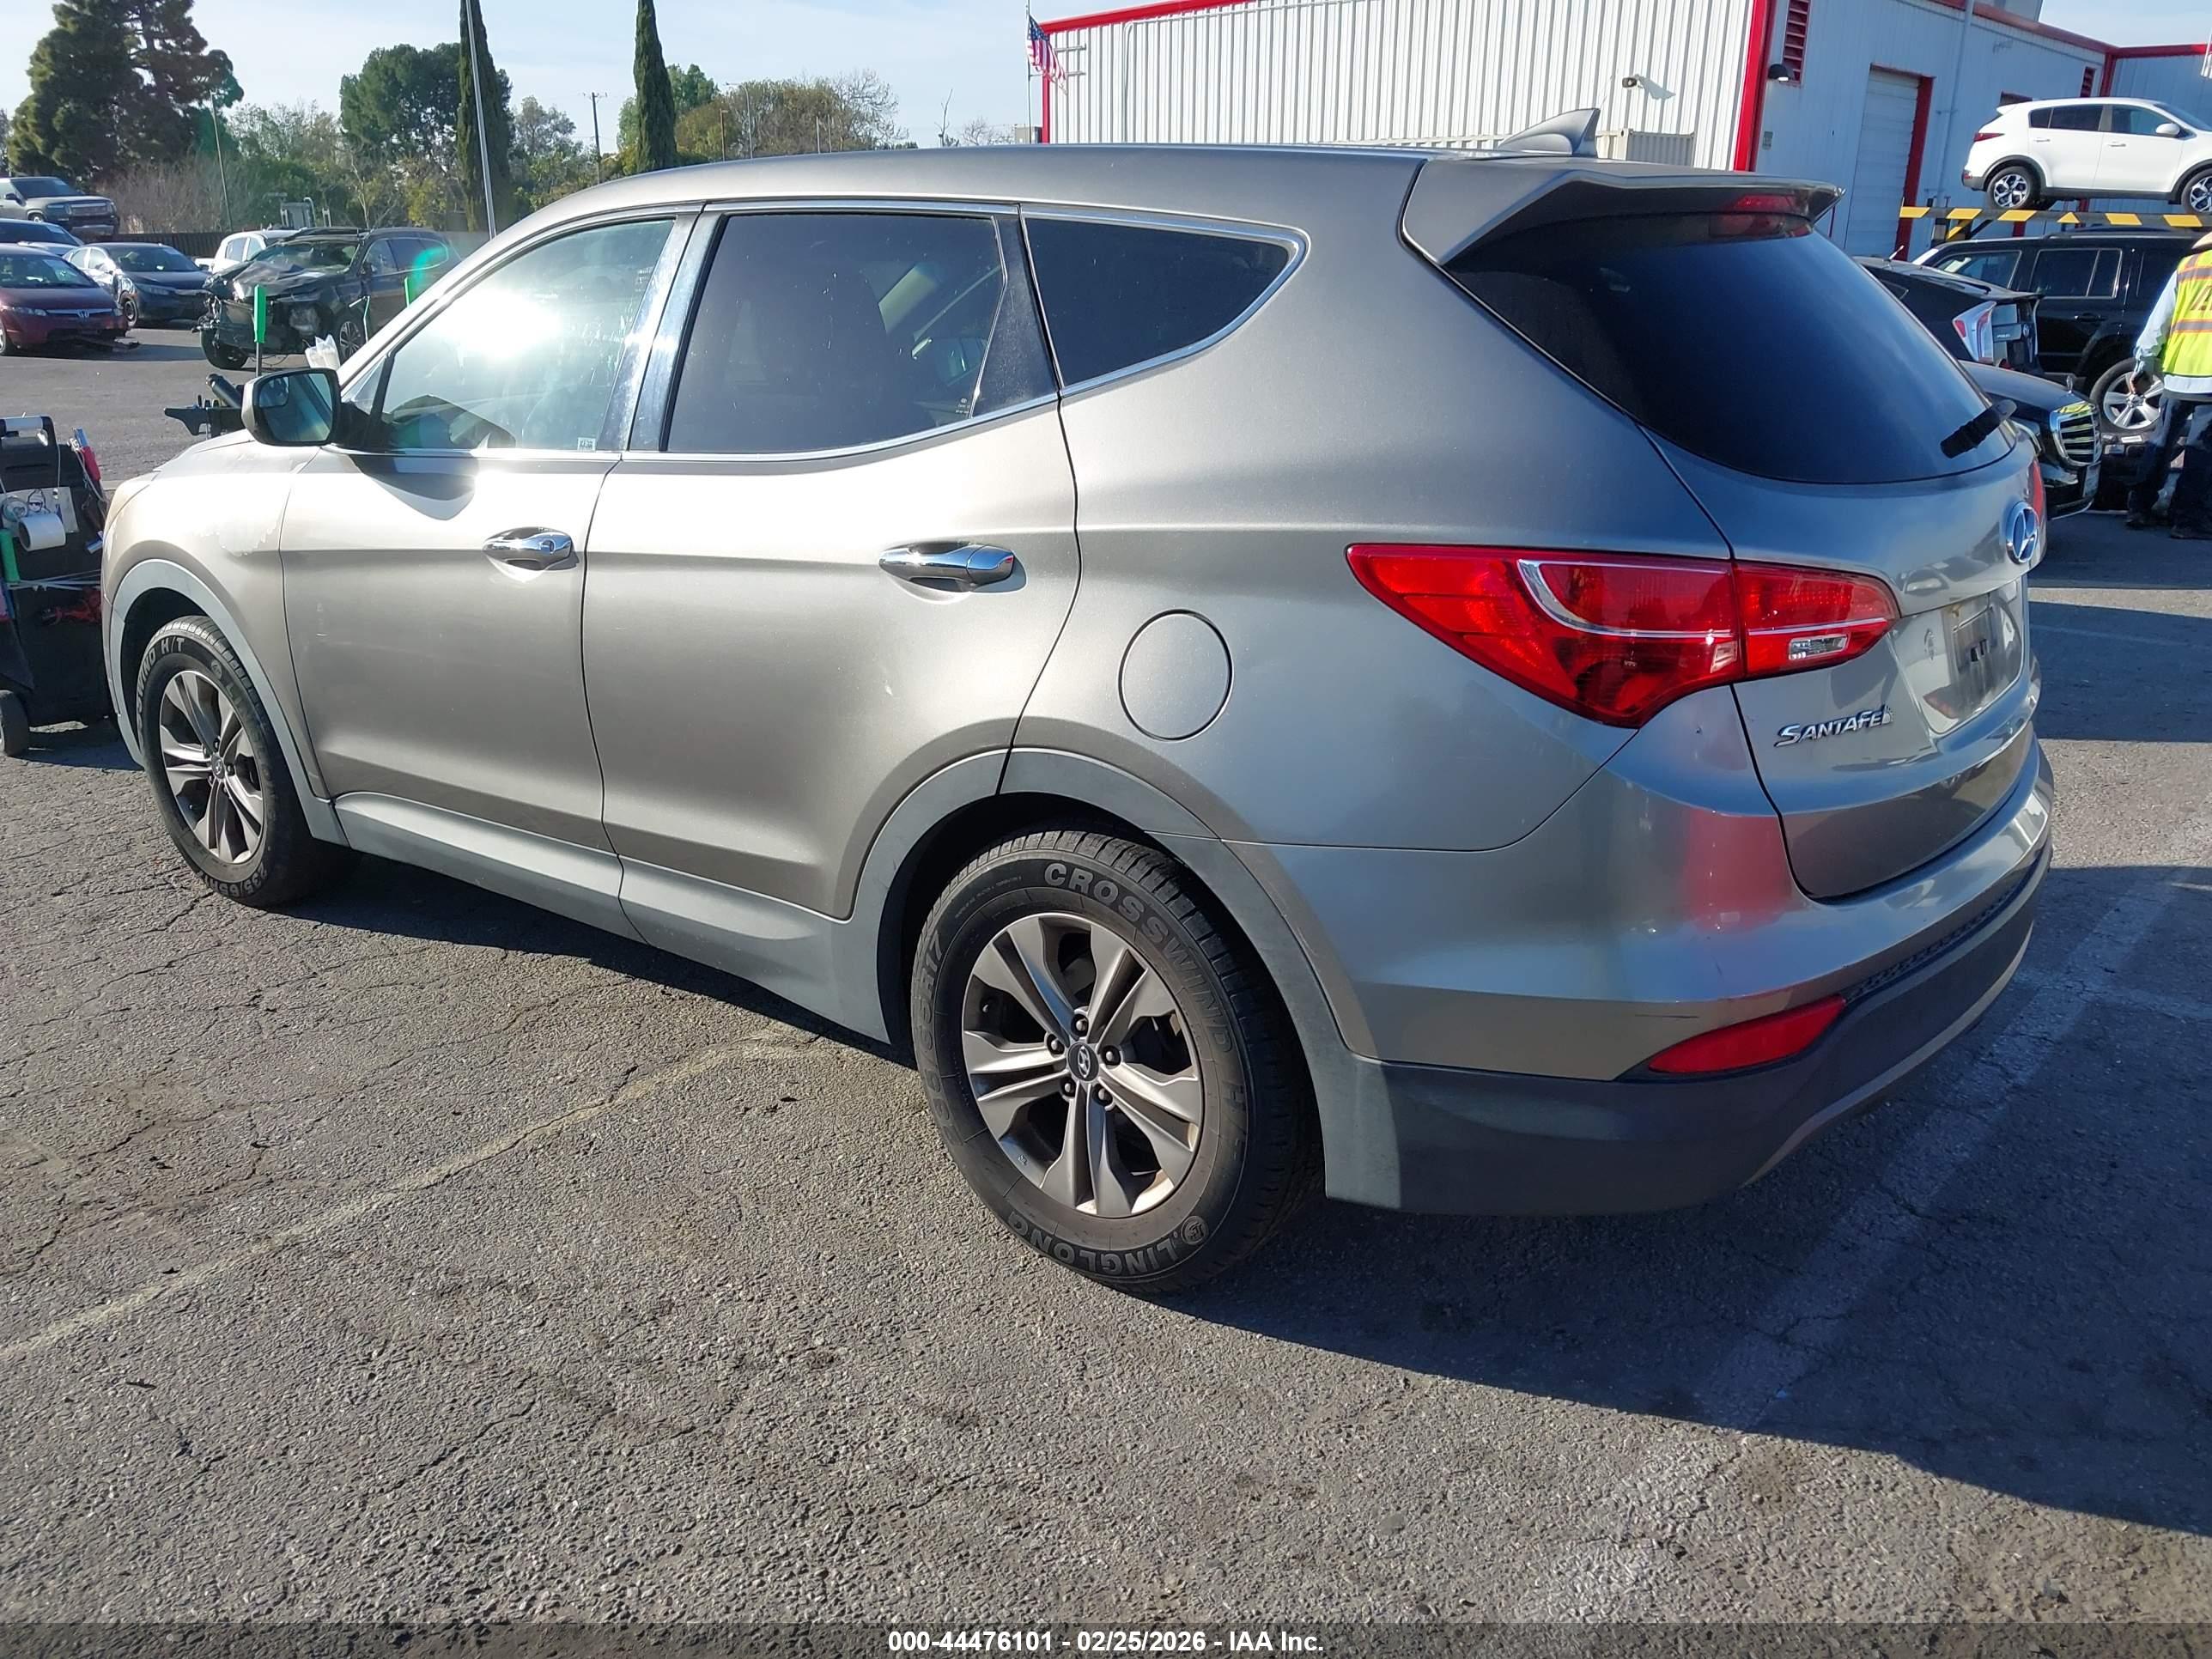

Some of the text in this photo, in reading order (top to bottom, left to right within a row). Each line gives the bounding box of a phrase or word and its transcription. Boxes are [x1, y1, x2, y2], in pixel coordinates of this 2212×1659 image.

[161, 636, 185, 654] H/T
[1044, 863, 1232, 1054] CROSSWIND
[1008, 1212, 1179, 1275] LINGLONG
